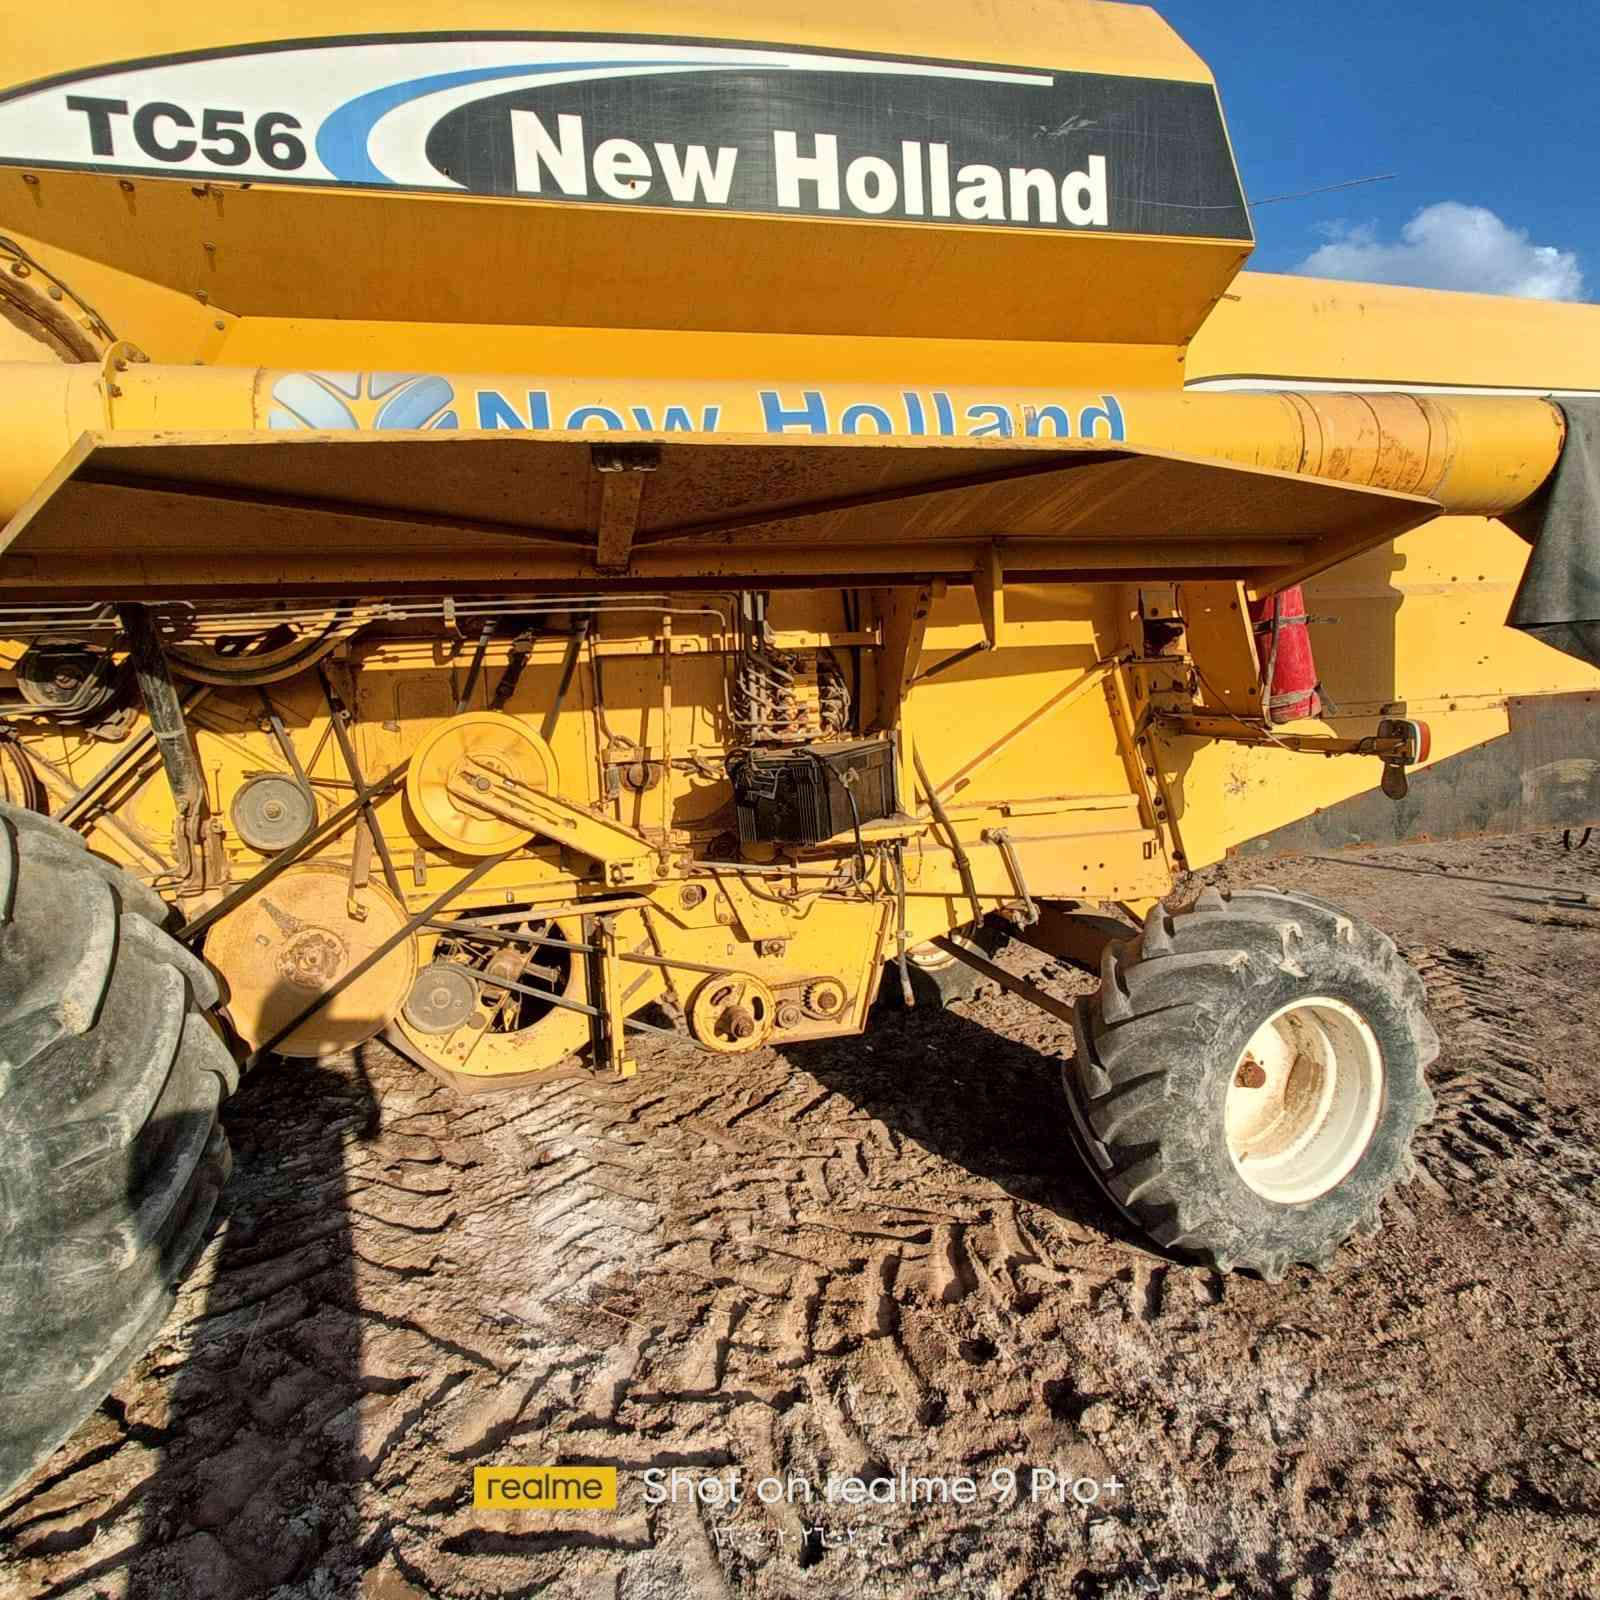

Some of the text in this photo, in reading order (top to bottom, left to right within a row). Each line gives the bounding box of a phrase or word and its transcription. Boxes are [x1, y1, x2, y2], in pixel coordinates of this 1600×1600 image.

[66, 95, 306, 171] TC56
[510, 109, 1108, 227] New Holland
[758, 390, 1126, 442] Holland
